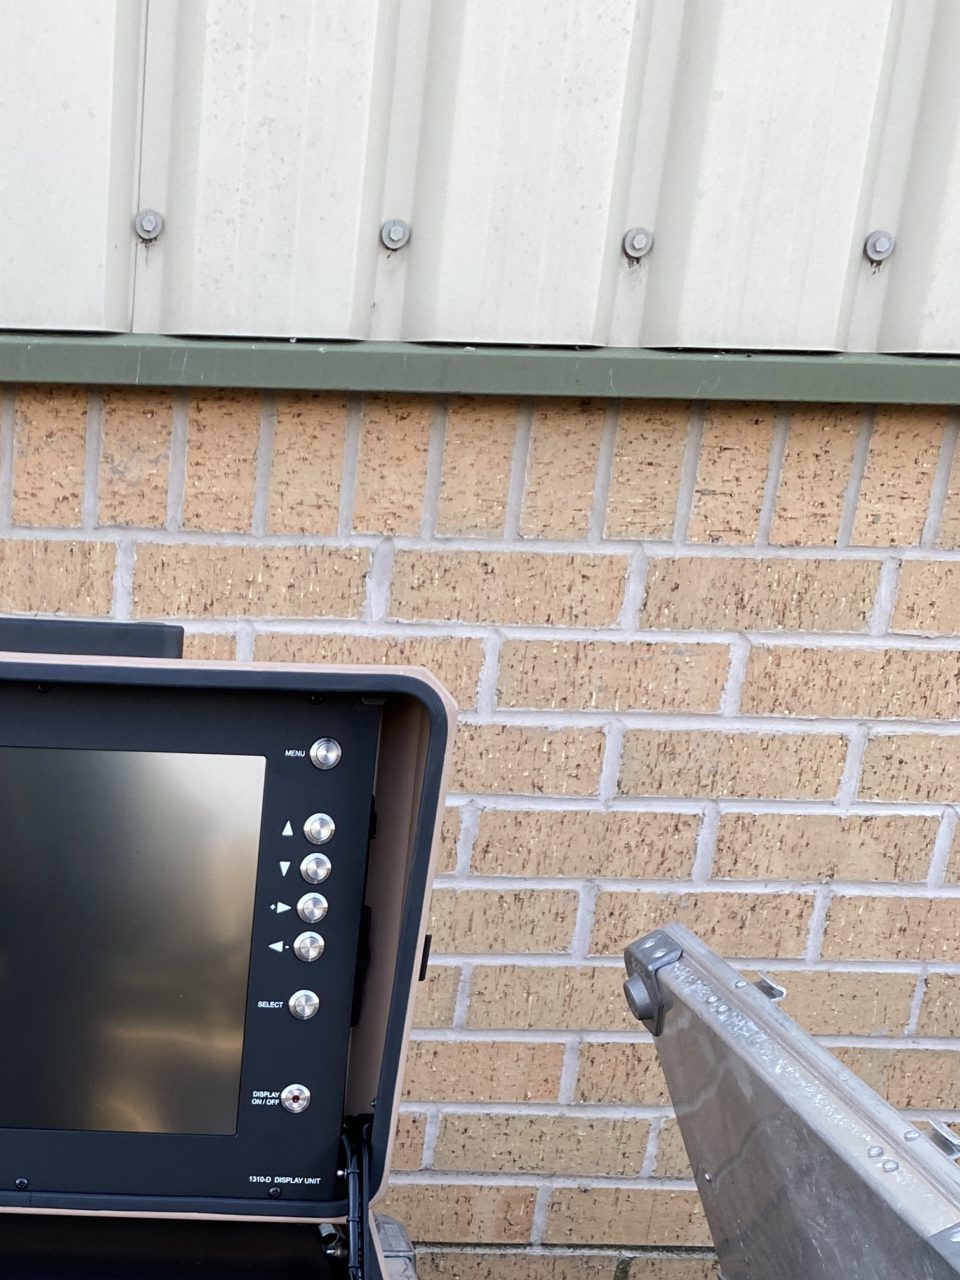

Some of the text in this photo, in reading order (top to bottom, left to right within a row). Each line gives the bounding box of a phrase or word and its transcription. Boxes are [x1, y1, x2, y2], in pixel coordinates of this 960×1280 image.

[285, 749, 305, 758] MENU
[258, 1000, 283, 1009] SELECT
[274, 1176, 303, 1184] DISPLAY
